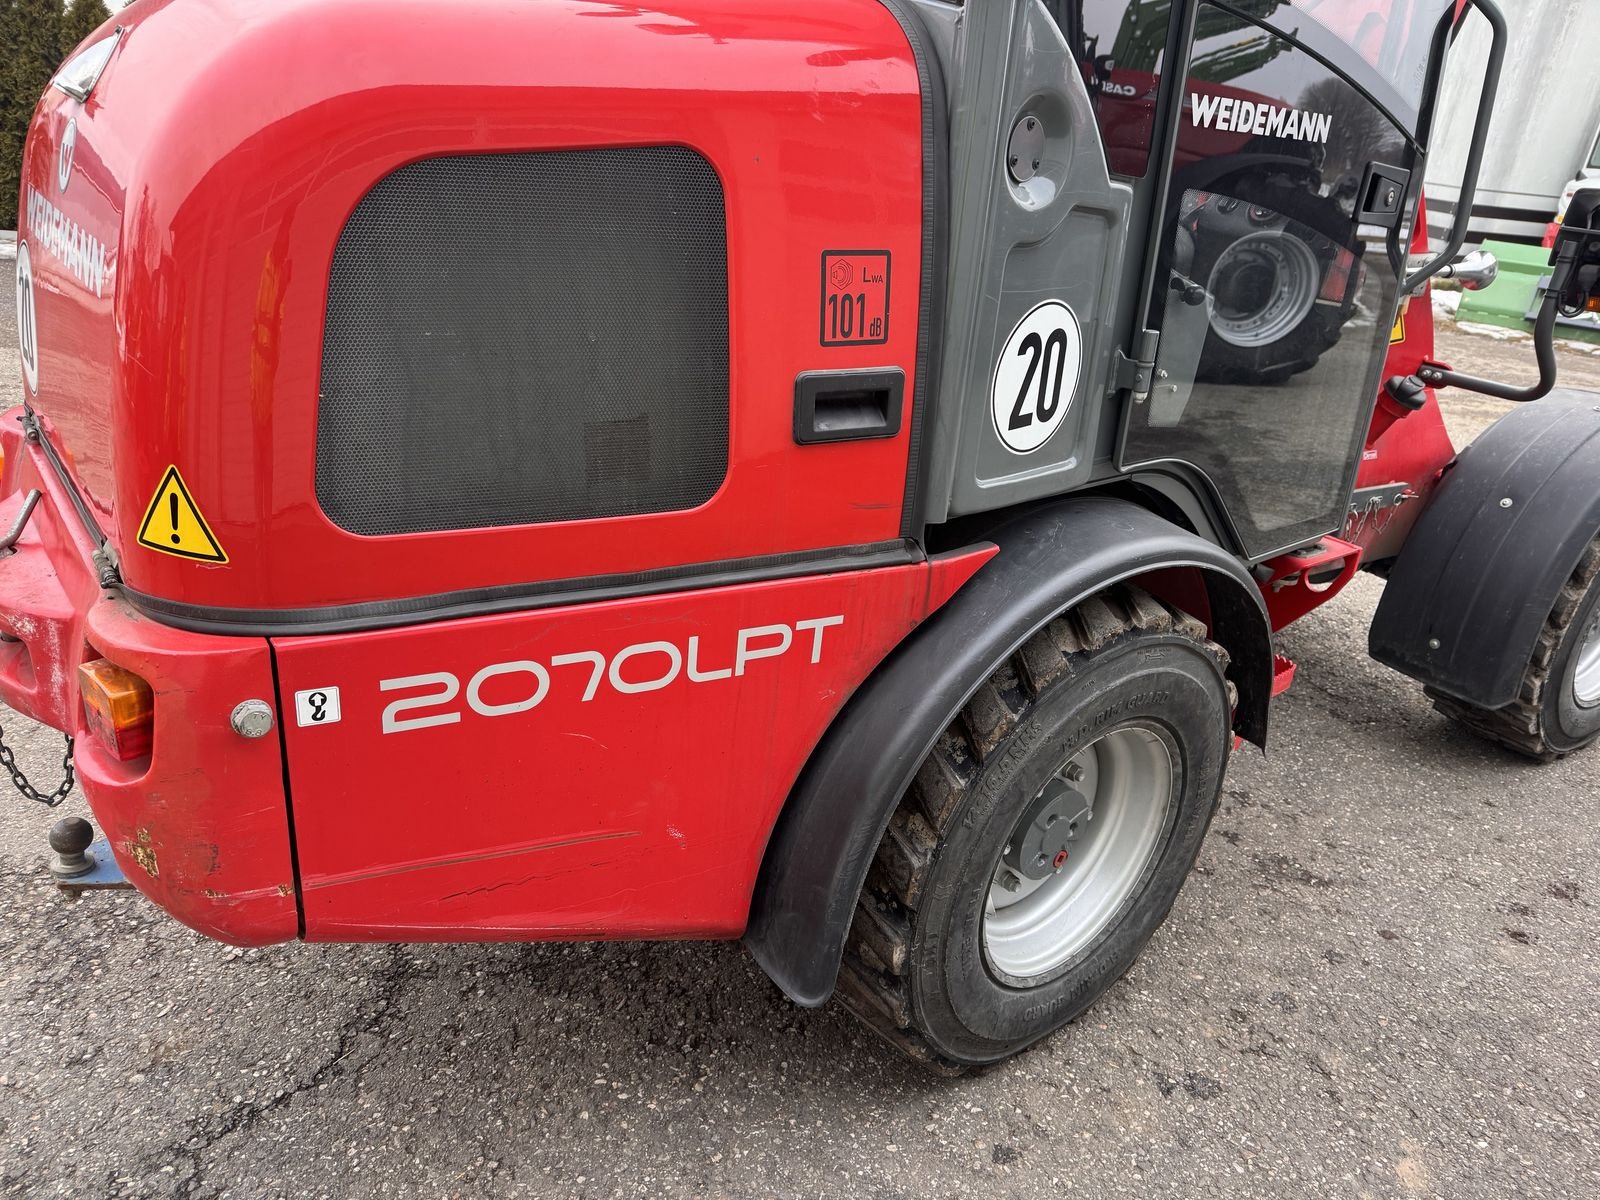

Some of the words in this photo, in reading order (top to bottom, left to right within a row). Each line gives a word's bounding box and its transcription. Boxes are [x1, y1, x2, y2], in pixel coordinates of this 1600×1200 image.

[1191, 92, 1332, 144] WEIDEMANN
[27, 183, 105, 299] WEIDEMANN
[18, 266, 35, 372] 20
[828, 292, 866, 339] 101
[869, 317, 882, 337] dB
[1008, 327, 1068, 431] 20
[379, 615, 845, 735] 2070LPT
